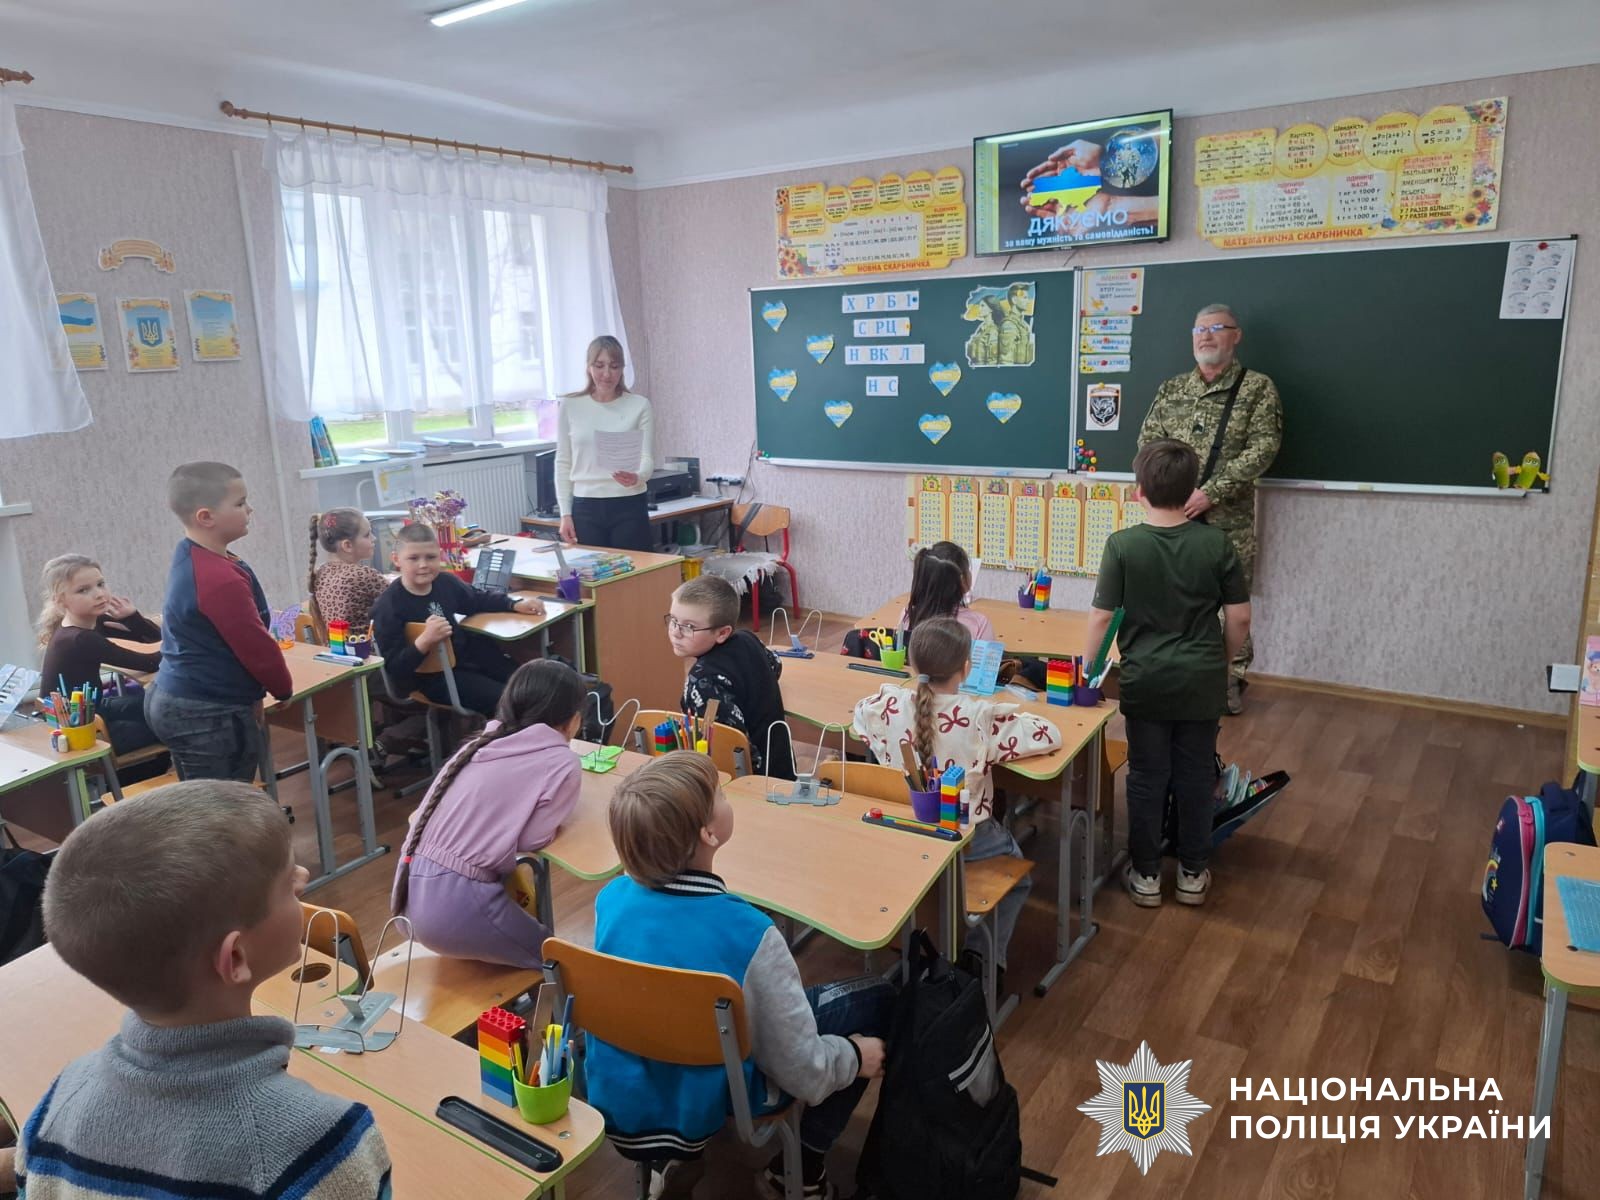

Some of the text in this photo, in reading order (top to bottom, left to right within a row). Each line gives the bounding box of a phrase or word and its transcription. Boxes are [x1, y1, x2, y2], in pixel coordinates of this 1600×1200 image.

[1028, 207, 1129, 236] ДЯКУЄМО
[1037, 236, 1073, 247] мужність
[1223, 228, 1363, 247] МАТЕМАТИЧНА СКАРБНИЧКА
[884, 261, 930, 271] СКАРБНИЧКА
[876, 320, 896, 335] РЦ
[870, 348, 889, 361] ВК
